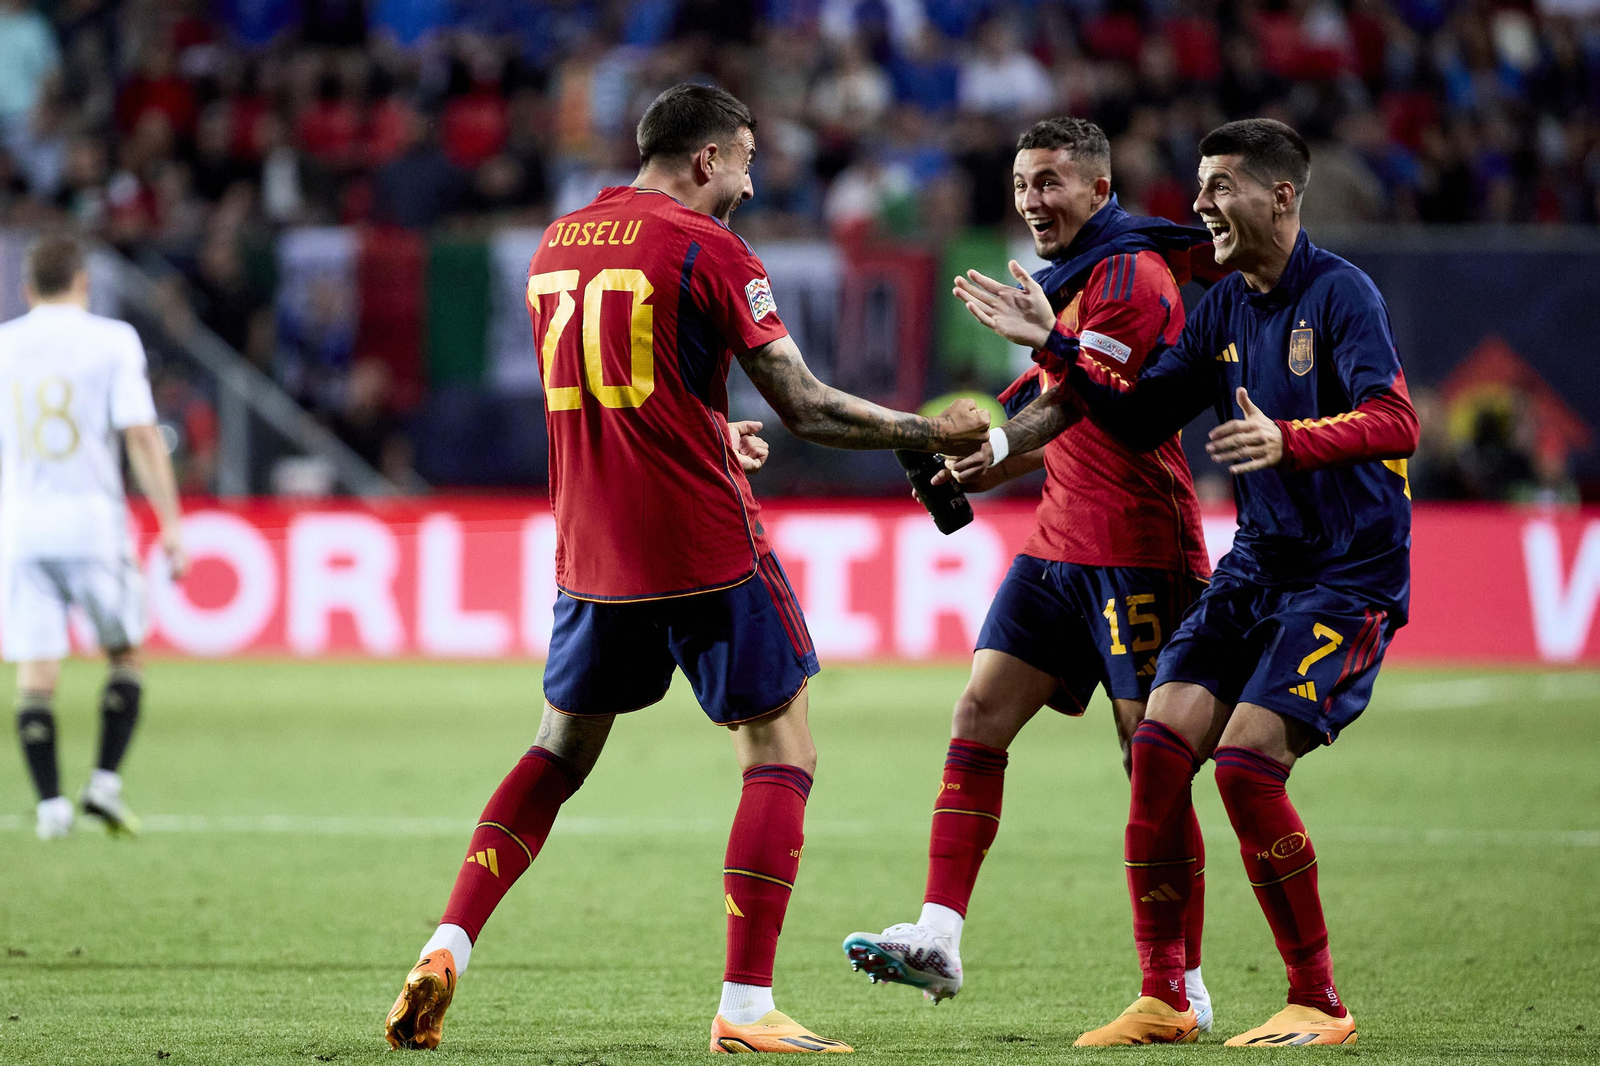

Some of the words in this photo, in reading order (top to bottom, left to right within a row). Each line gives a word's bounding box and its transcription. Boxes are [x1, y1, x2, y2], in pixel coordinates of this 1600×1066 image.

[548, 219, 643, 247] JOSELU
[526, 267, 656, 413] 20
[11, 374, 81, 463] 18
[72, 509, 557, 660] ORL
[1102, 593, 1162, 655] 15
[1296, 621, 1344, 677] 7
